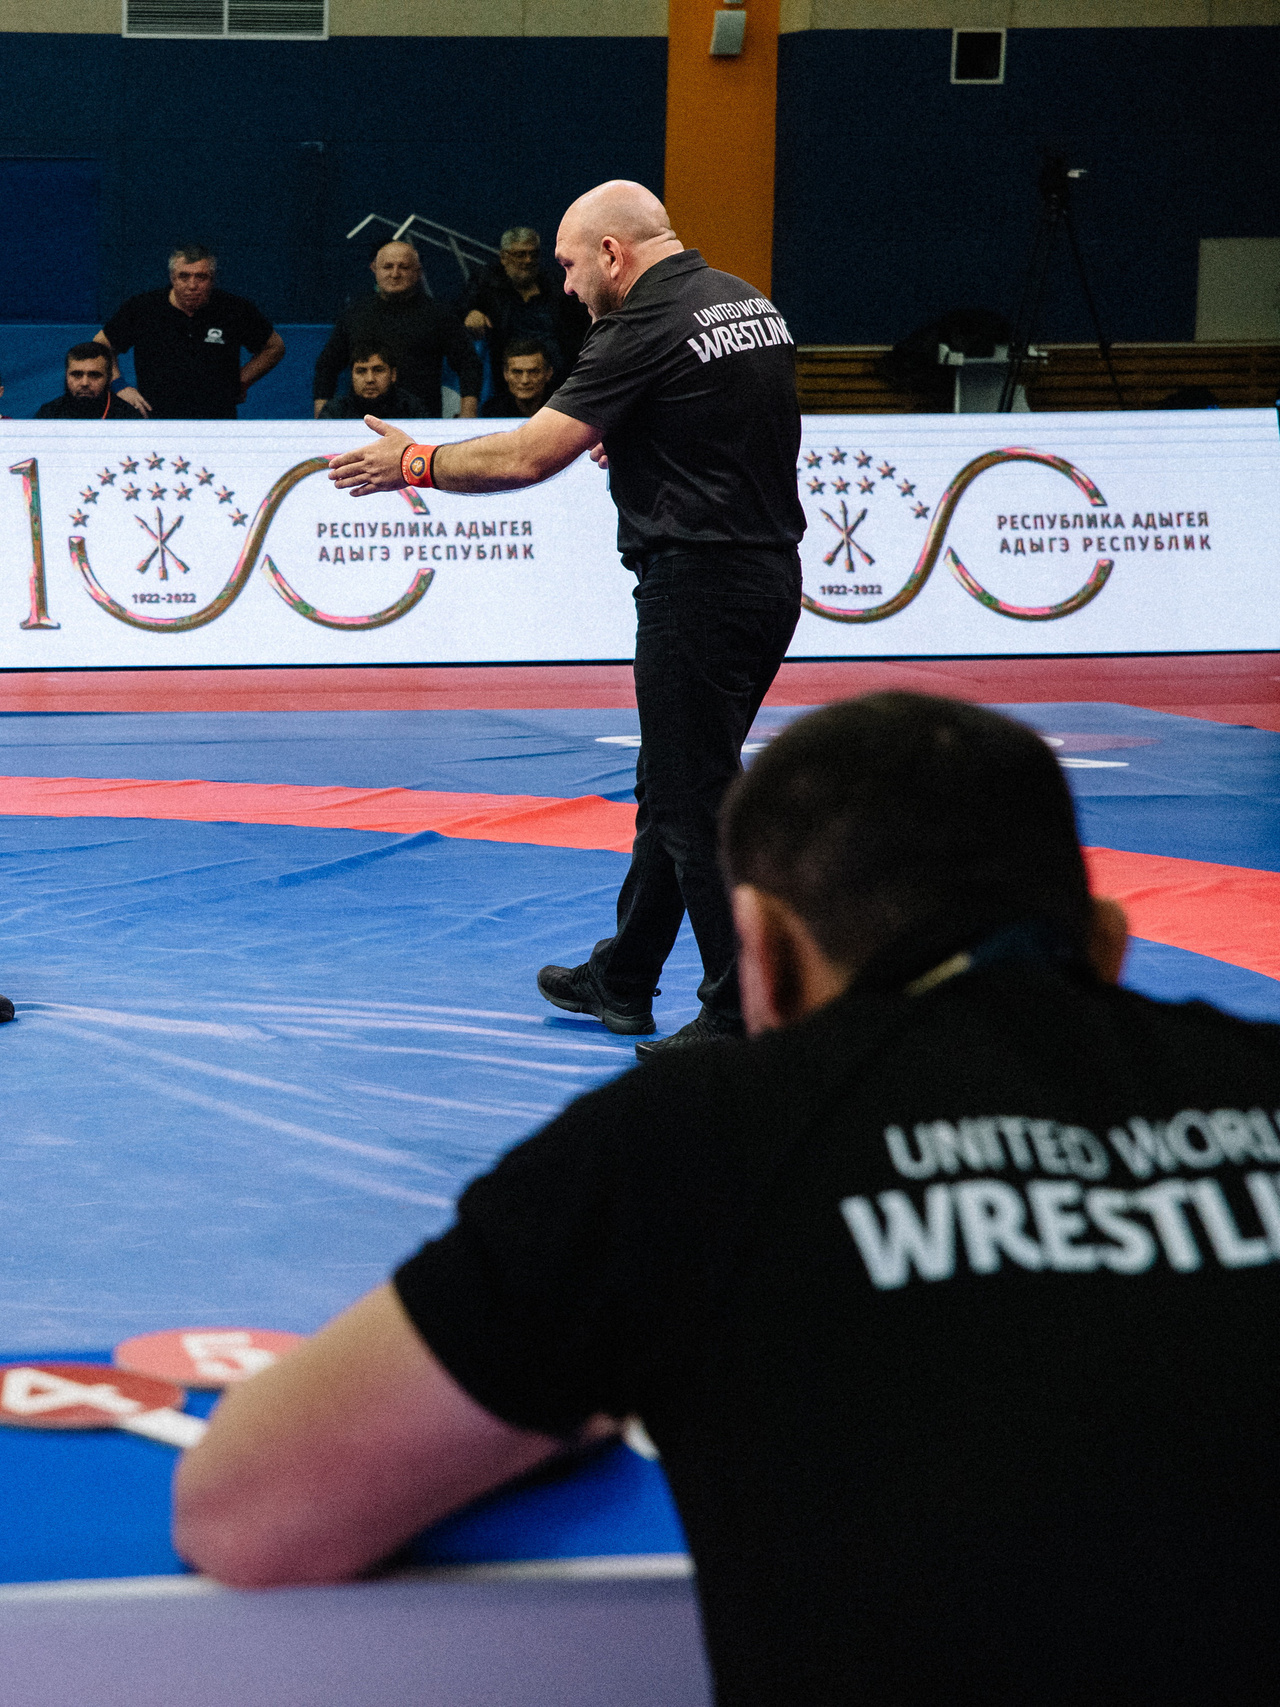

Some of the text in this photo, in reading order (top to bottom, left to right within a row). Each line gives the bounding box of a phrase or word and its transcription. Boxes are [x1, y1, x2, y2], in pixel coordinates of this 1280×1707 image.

[694, 303, 742, 327] UNITED
[317, 521, 533, 539] РЕСПУБЛИКА АДЫГЕЯ
[997, 511, 1209, 530] РЕСПУБЛИКА АДЫГЕЯ
[318, 544, 535, 564] АДЫГЭ РЕСПУБЛИК
[1000, 535, 1211, 556] АДЫГЭ РЕСПУБЛИК
[131, 593, 197, 604] 1922-2022
[820, 584, 883, 595] 1922-2022
[885, 1108, 1280, 1179] UNITED WORL
[840, 1172, 1280, 1290] WRESTLI
[0, 1368, 143, 1415] 4
